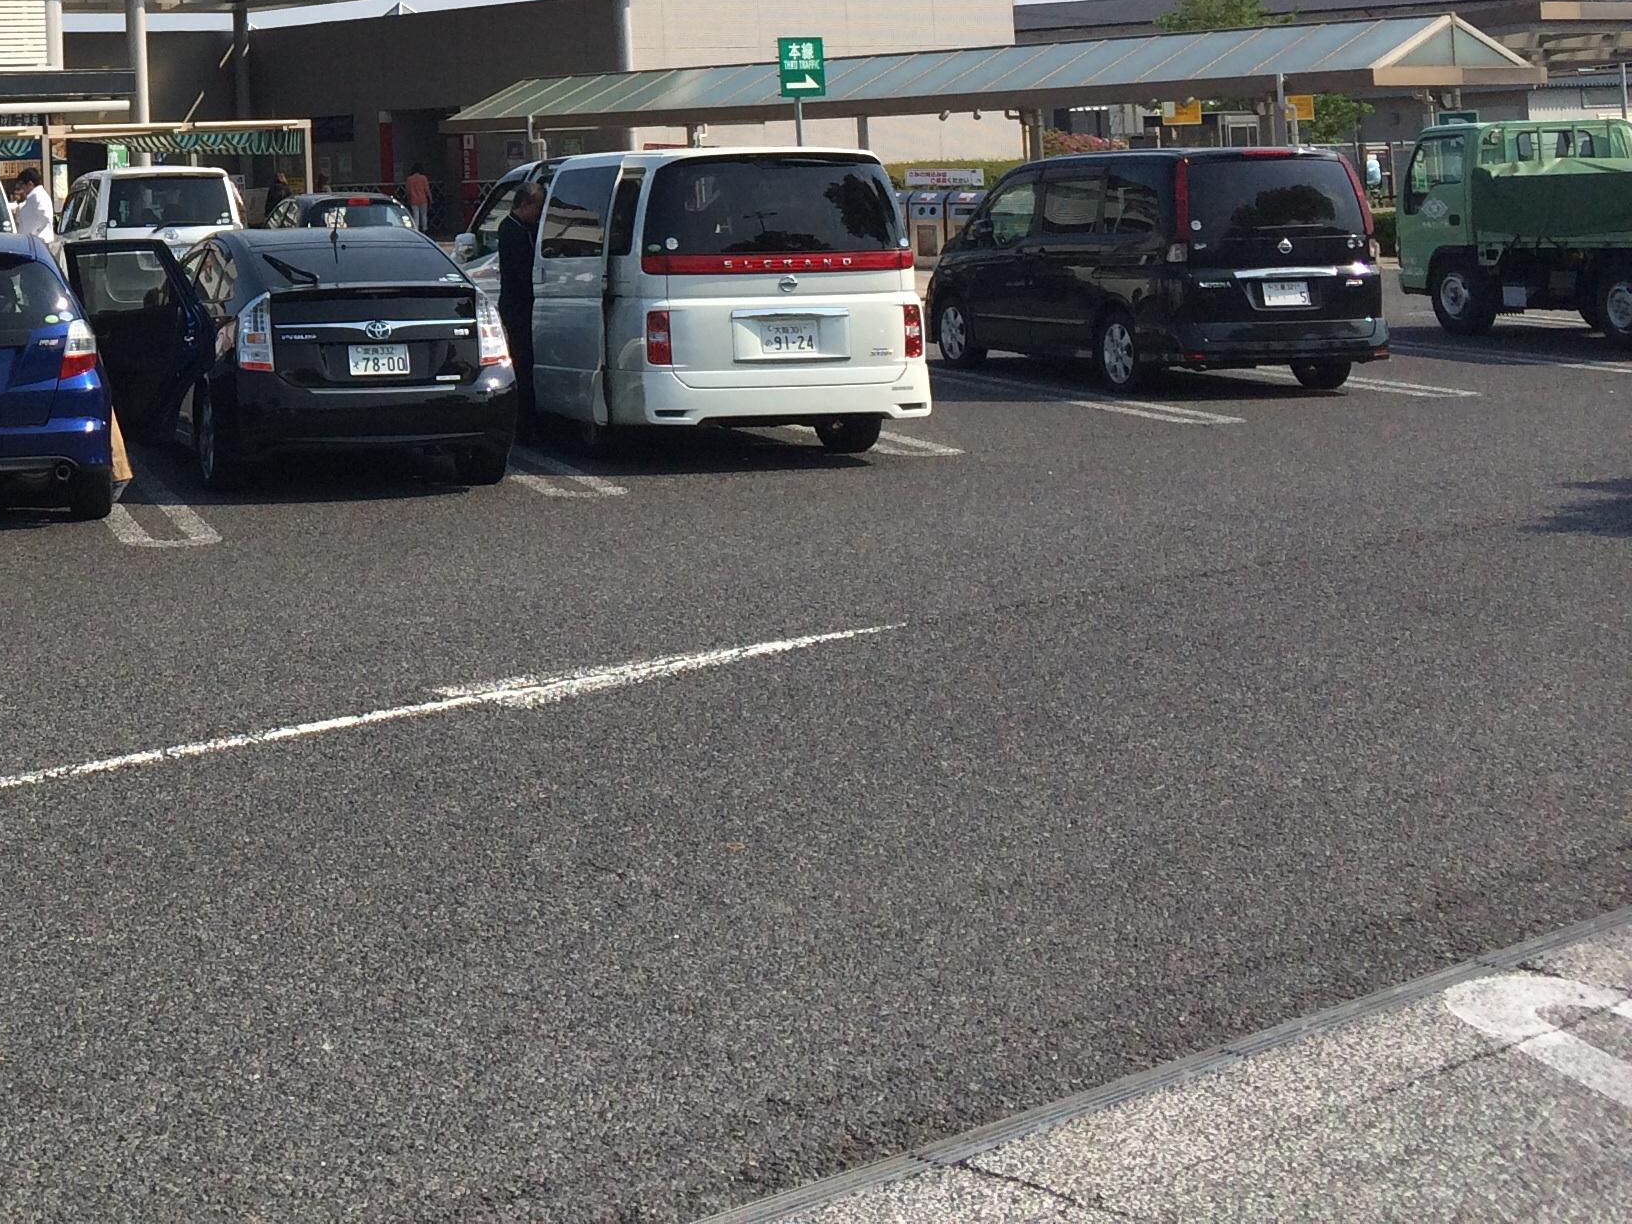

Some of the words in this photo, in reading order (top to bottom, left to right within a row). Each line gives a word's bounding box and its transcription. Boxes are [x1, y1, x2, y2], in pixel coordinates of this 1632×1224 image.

[788, 42, 814, 60] 本線
[774, 335, 814, 350] 91-24
[362, 356, 405, 373] 78-00
